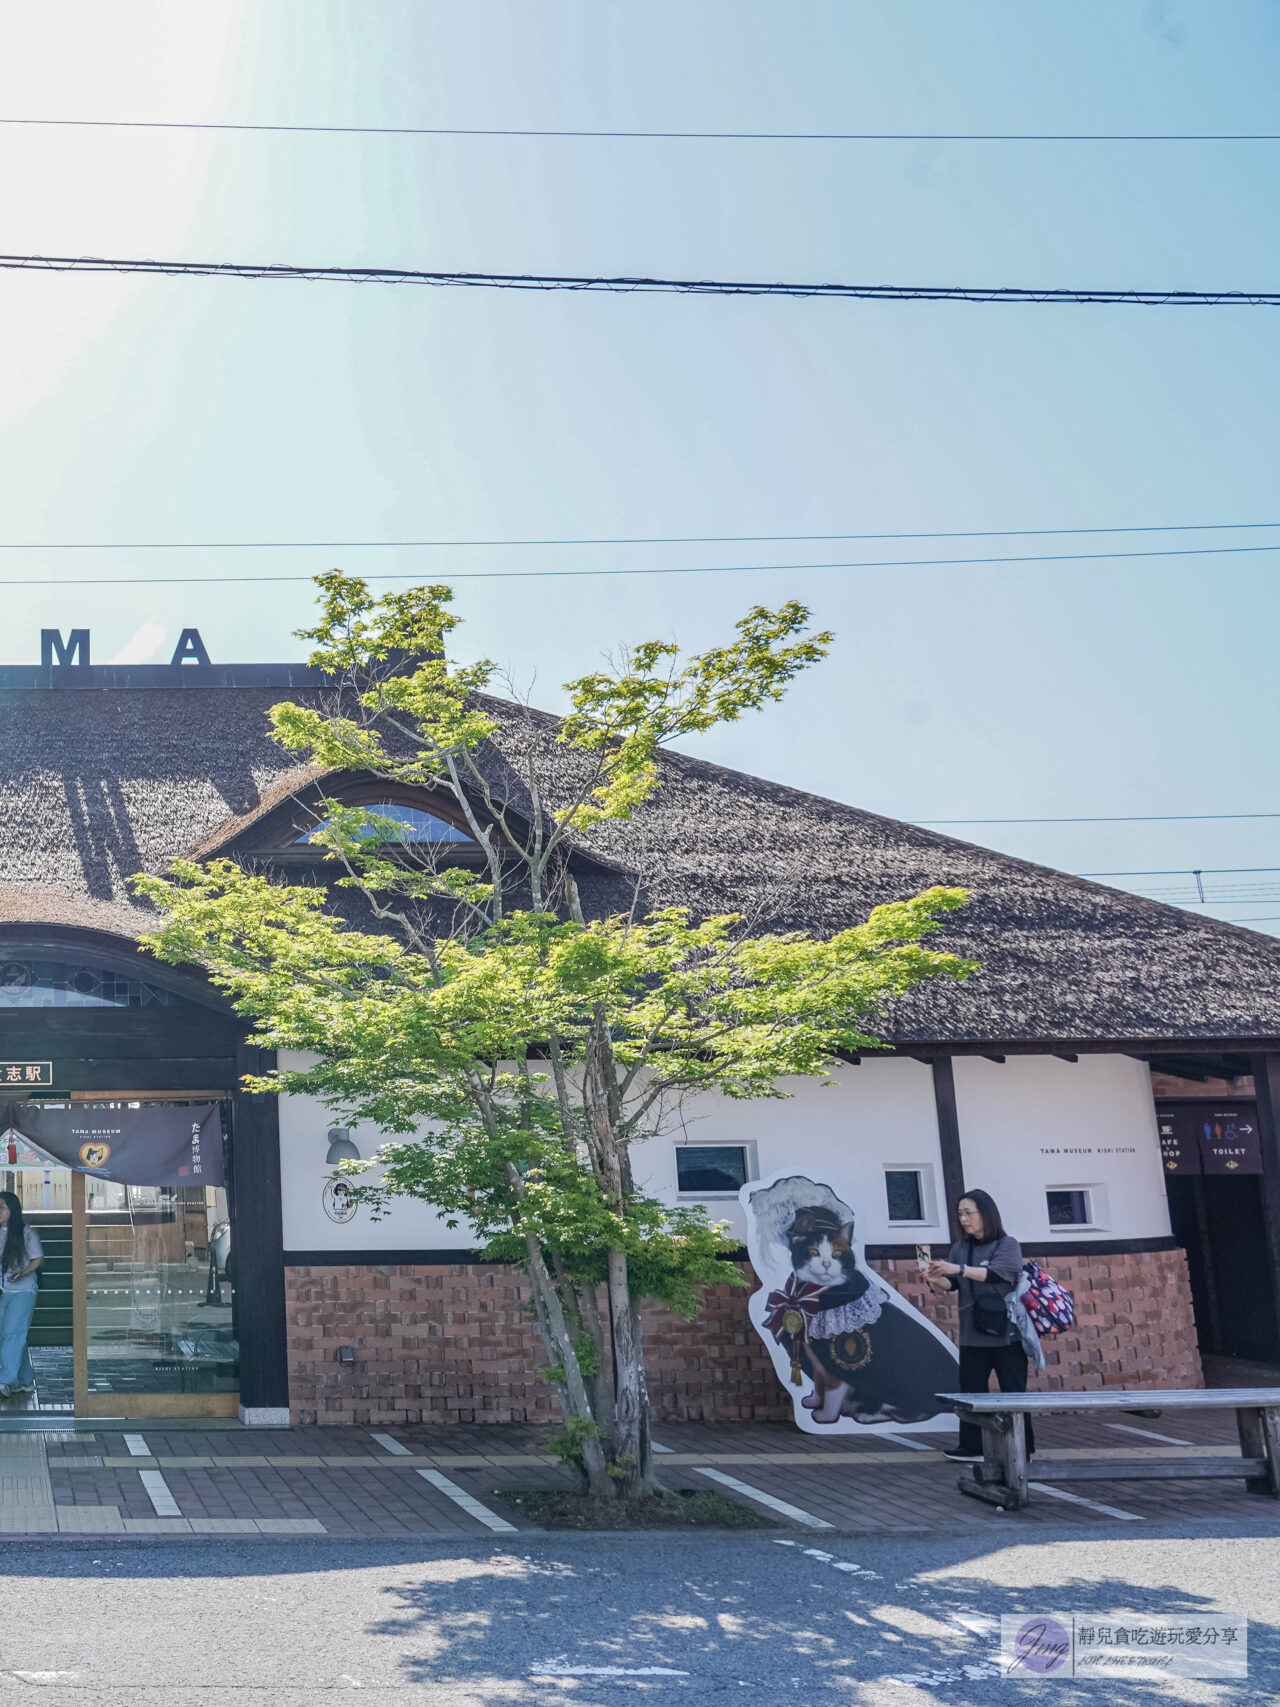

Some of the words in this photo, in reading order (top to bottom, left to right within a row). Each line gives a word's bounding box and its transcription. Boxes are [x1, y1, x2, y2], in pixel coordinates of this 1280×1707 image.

[191, 1122, 202, 1174] たま博物館
